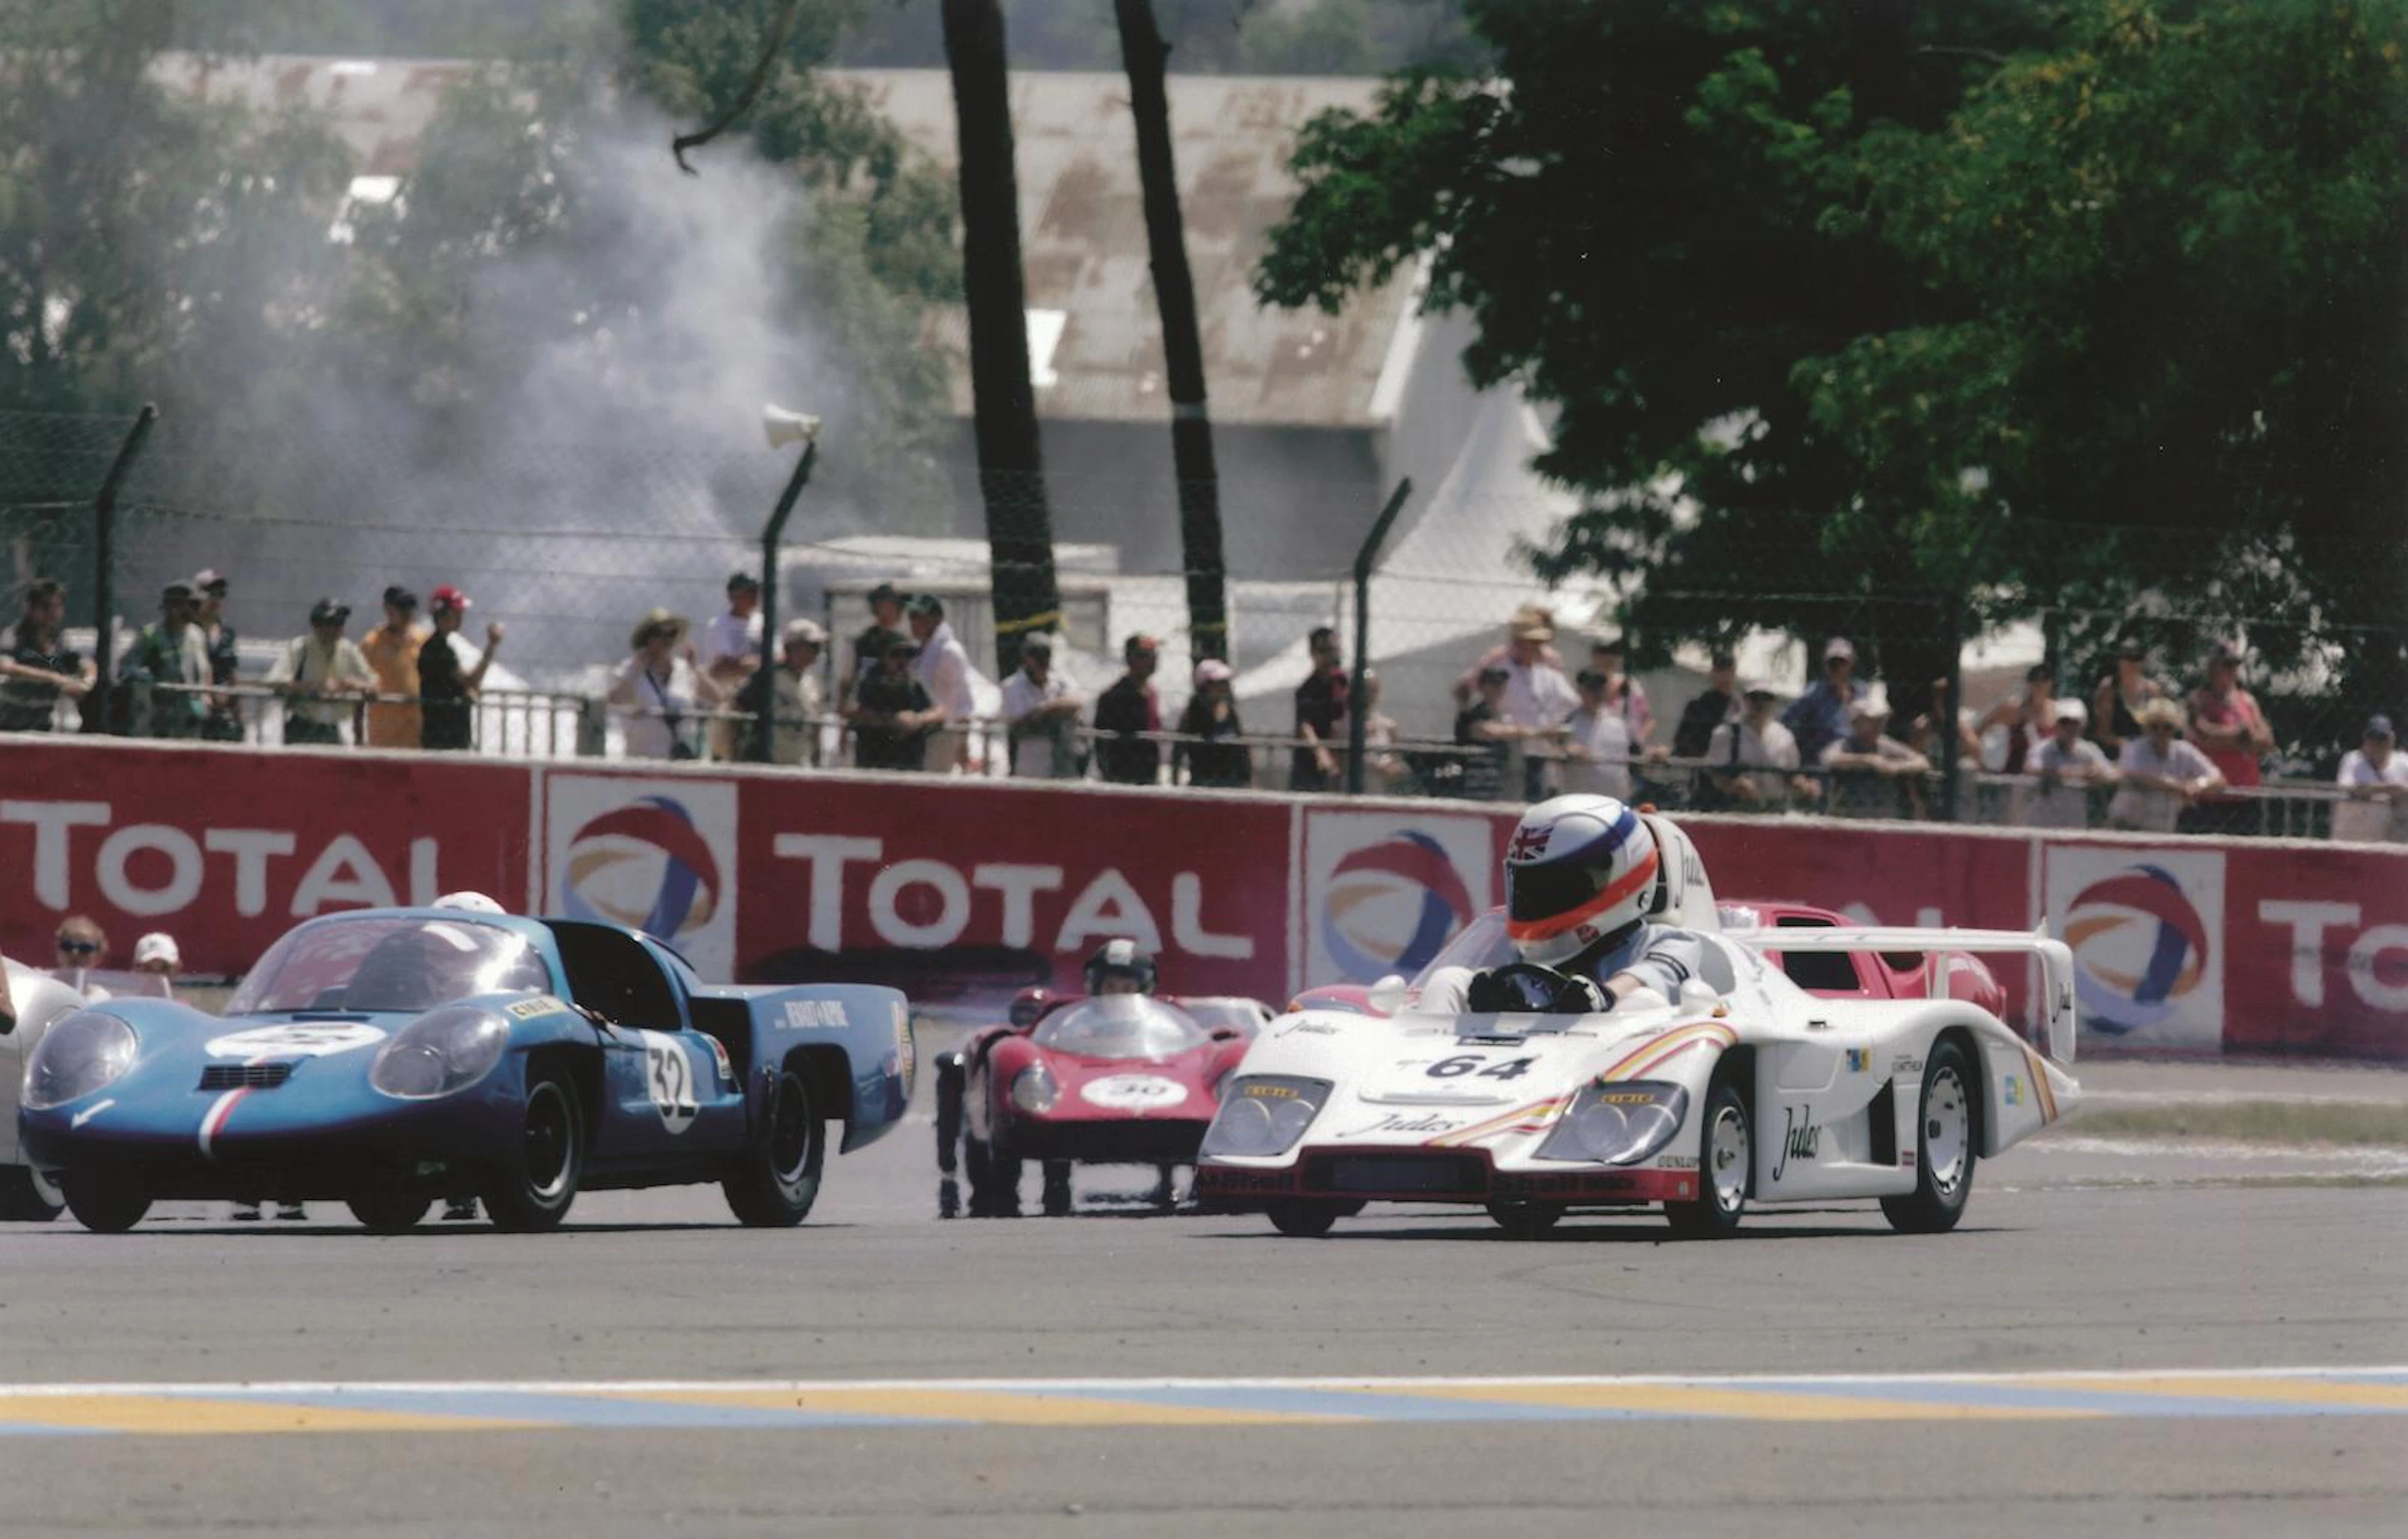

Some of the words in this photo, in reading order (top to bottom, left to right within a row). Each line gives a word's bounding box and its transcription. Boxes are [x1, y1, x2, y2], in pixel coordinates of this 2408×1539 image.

[773, 833, 1254, 959] TOTAL
[650, 1048, 694, 1118] 32
[1425, 1054, 1543, 1081] 64
[1336, 1112, 1467, 1138] Jules
[1772, 1103, 1822, 1182] Jules
